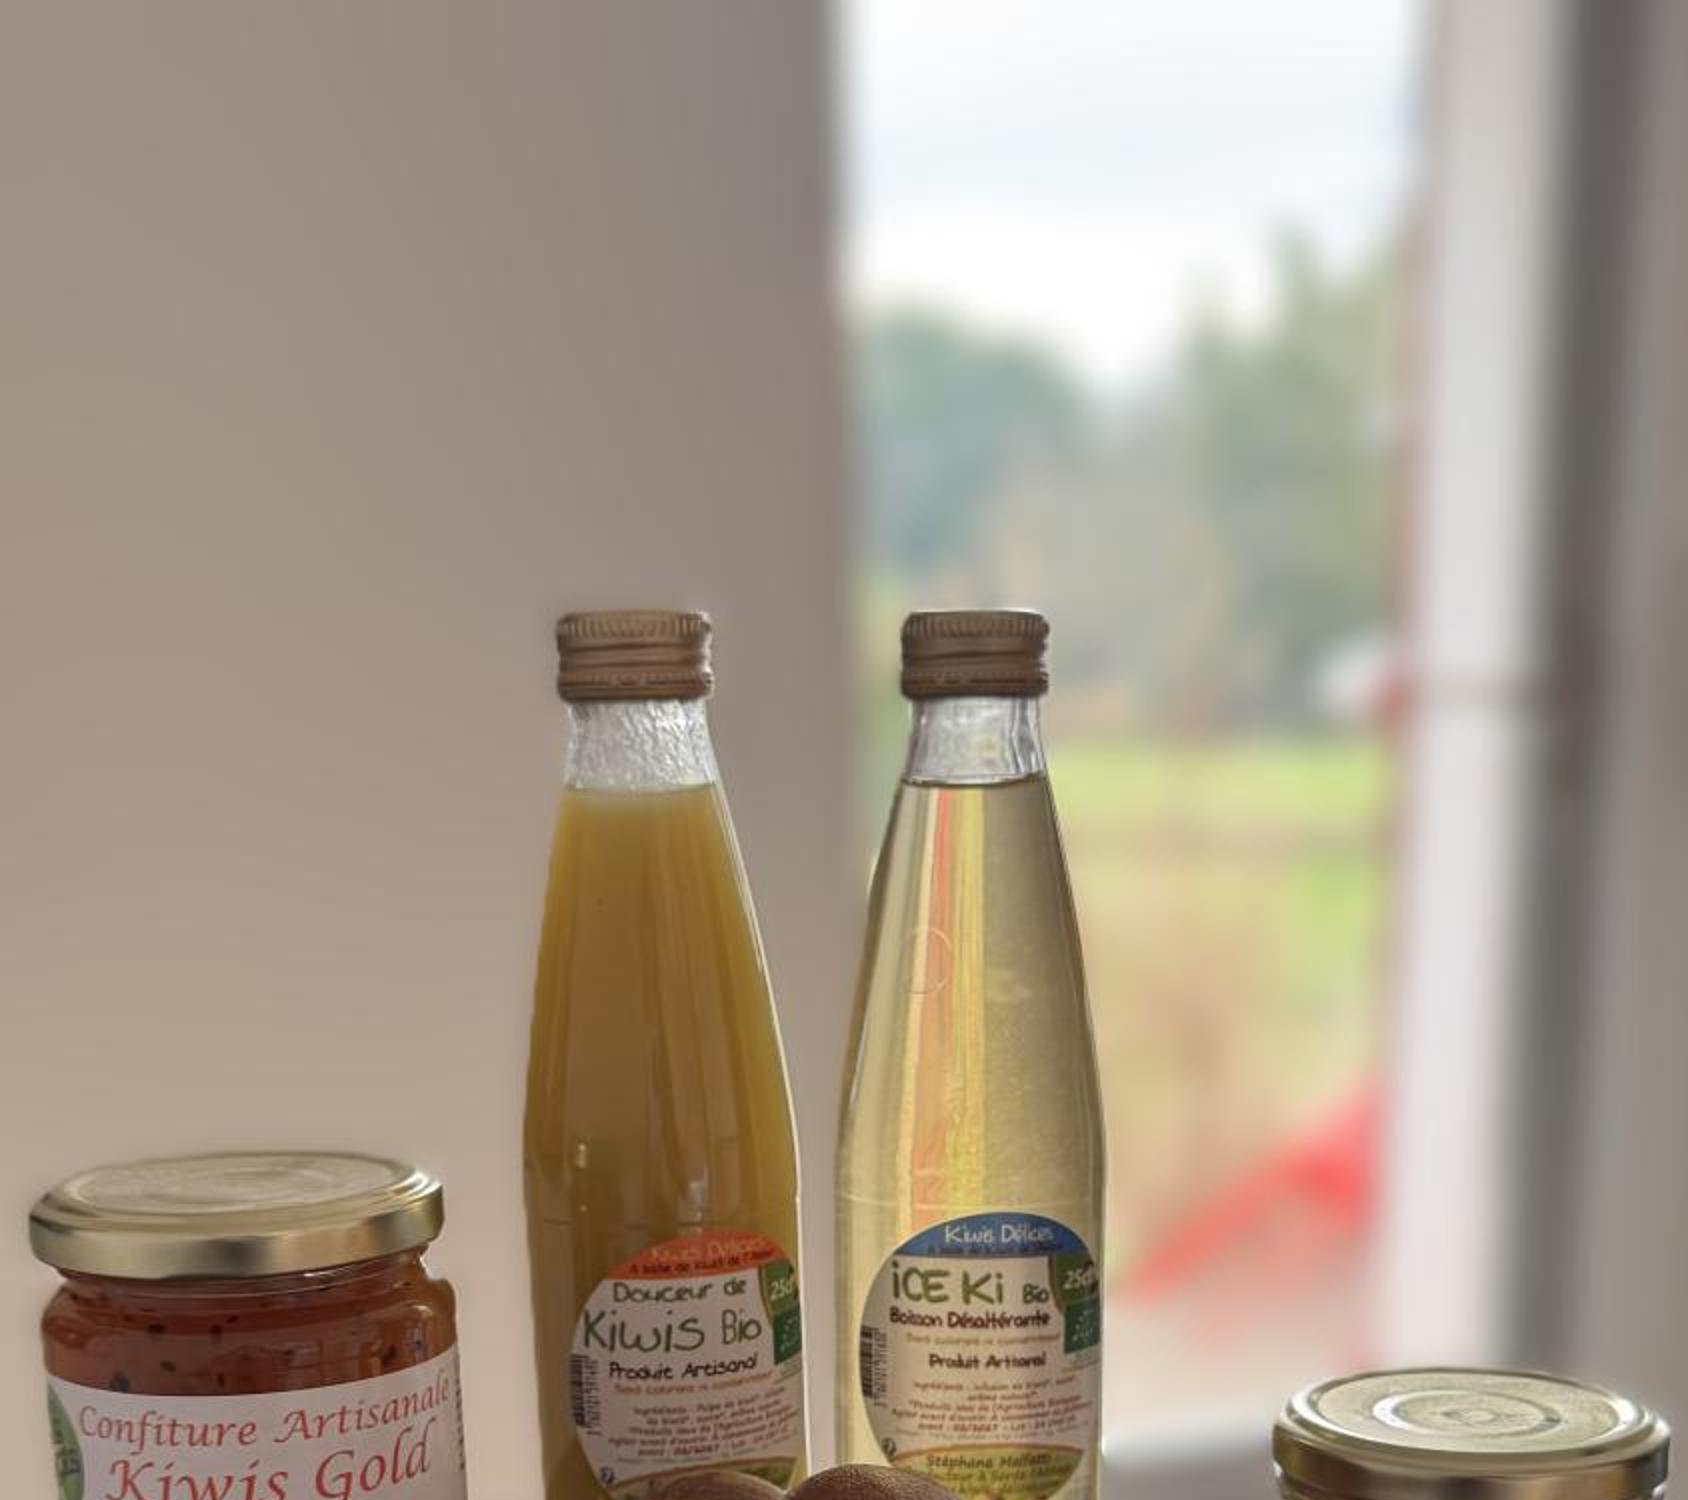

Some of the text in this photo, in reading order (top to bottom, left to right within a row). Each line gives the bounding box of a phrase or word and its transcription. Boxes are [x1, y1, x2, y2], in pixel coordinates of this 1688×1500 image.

[613, 1278, 747, 1303] Douceur de
[890, 1306, 1050, 1329] Boisson Désaltérante
[583, 1309, 763, 1354] Kiwis Bio
[609, 1352, 759, 1380] Produit Artisanal
[929, 1352, 1047, 1369] Produit Artisanal
[79, 1405, 257, 1457] Confiture
[273, 1368, 450, 1443] Artisanale
